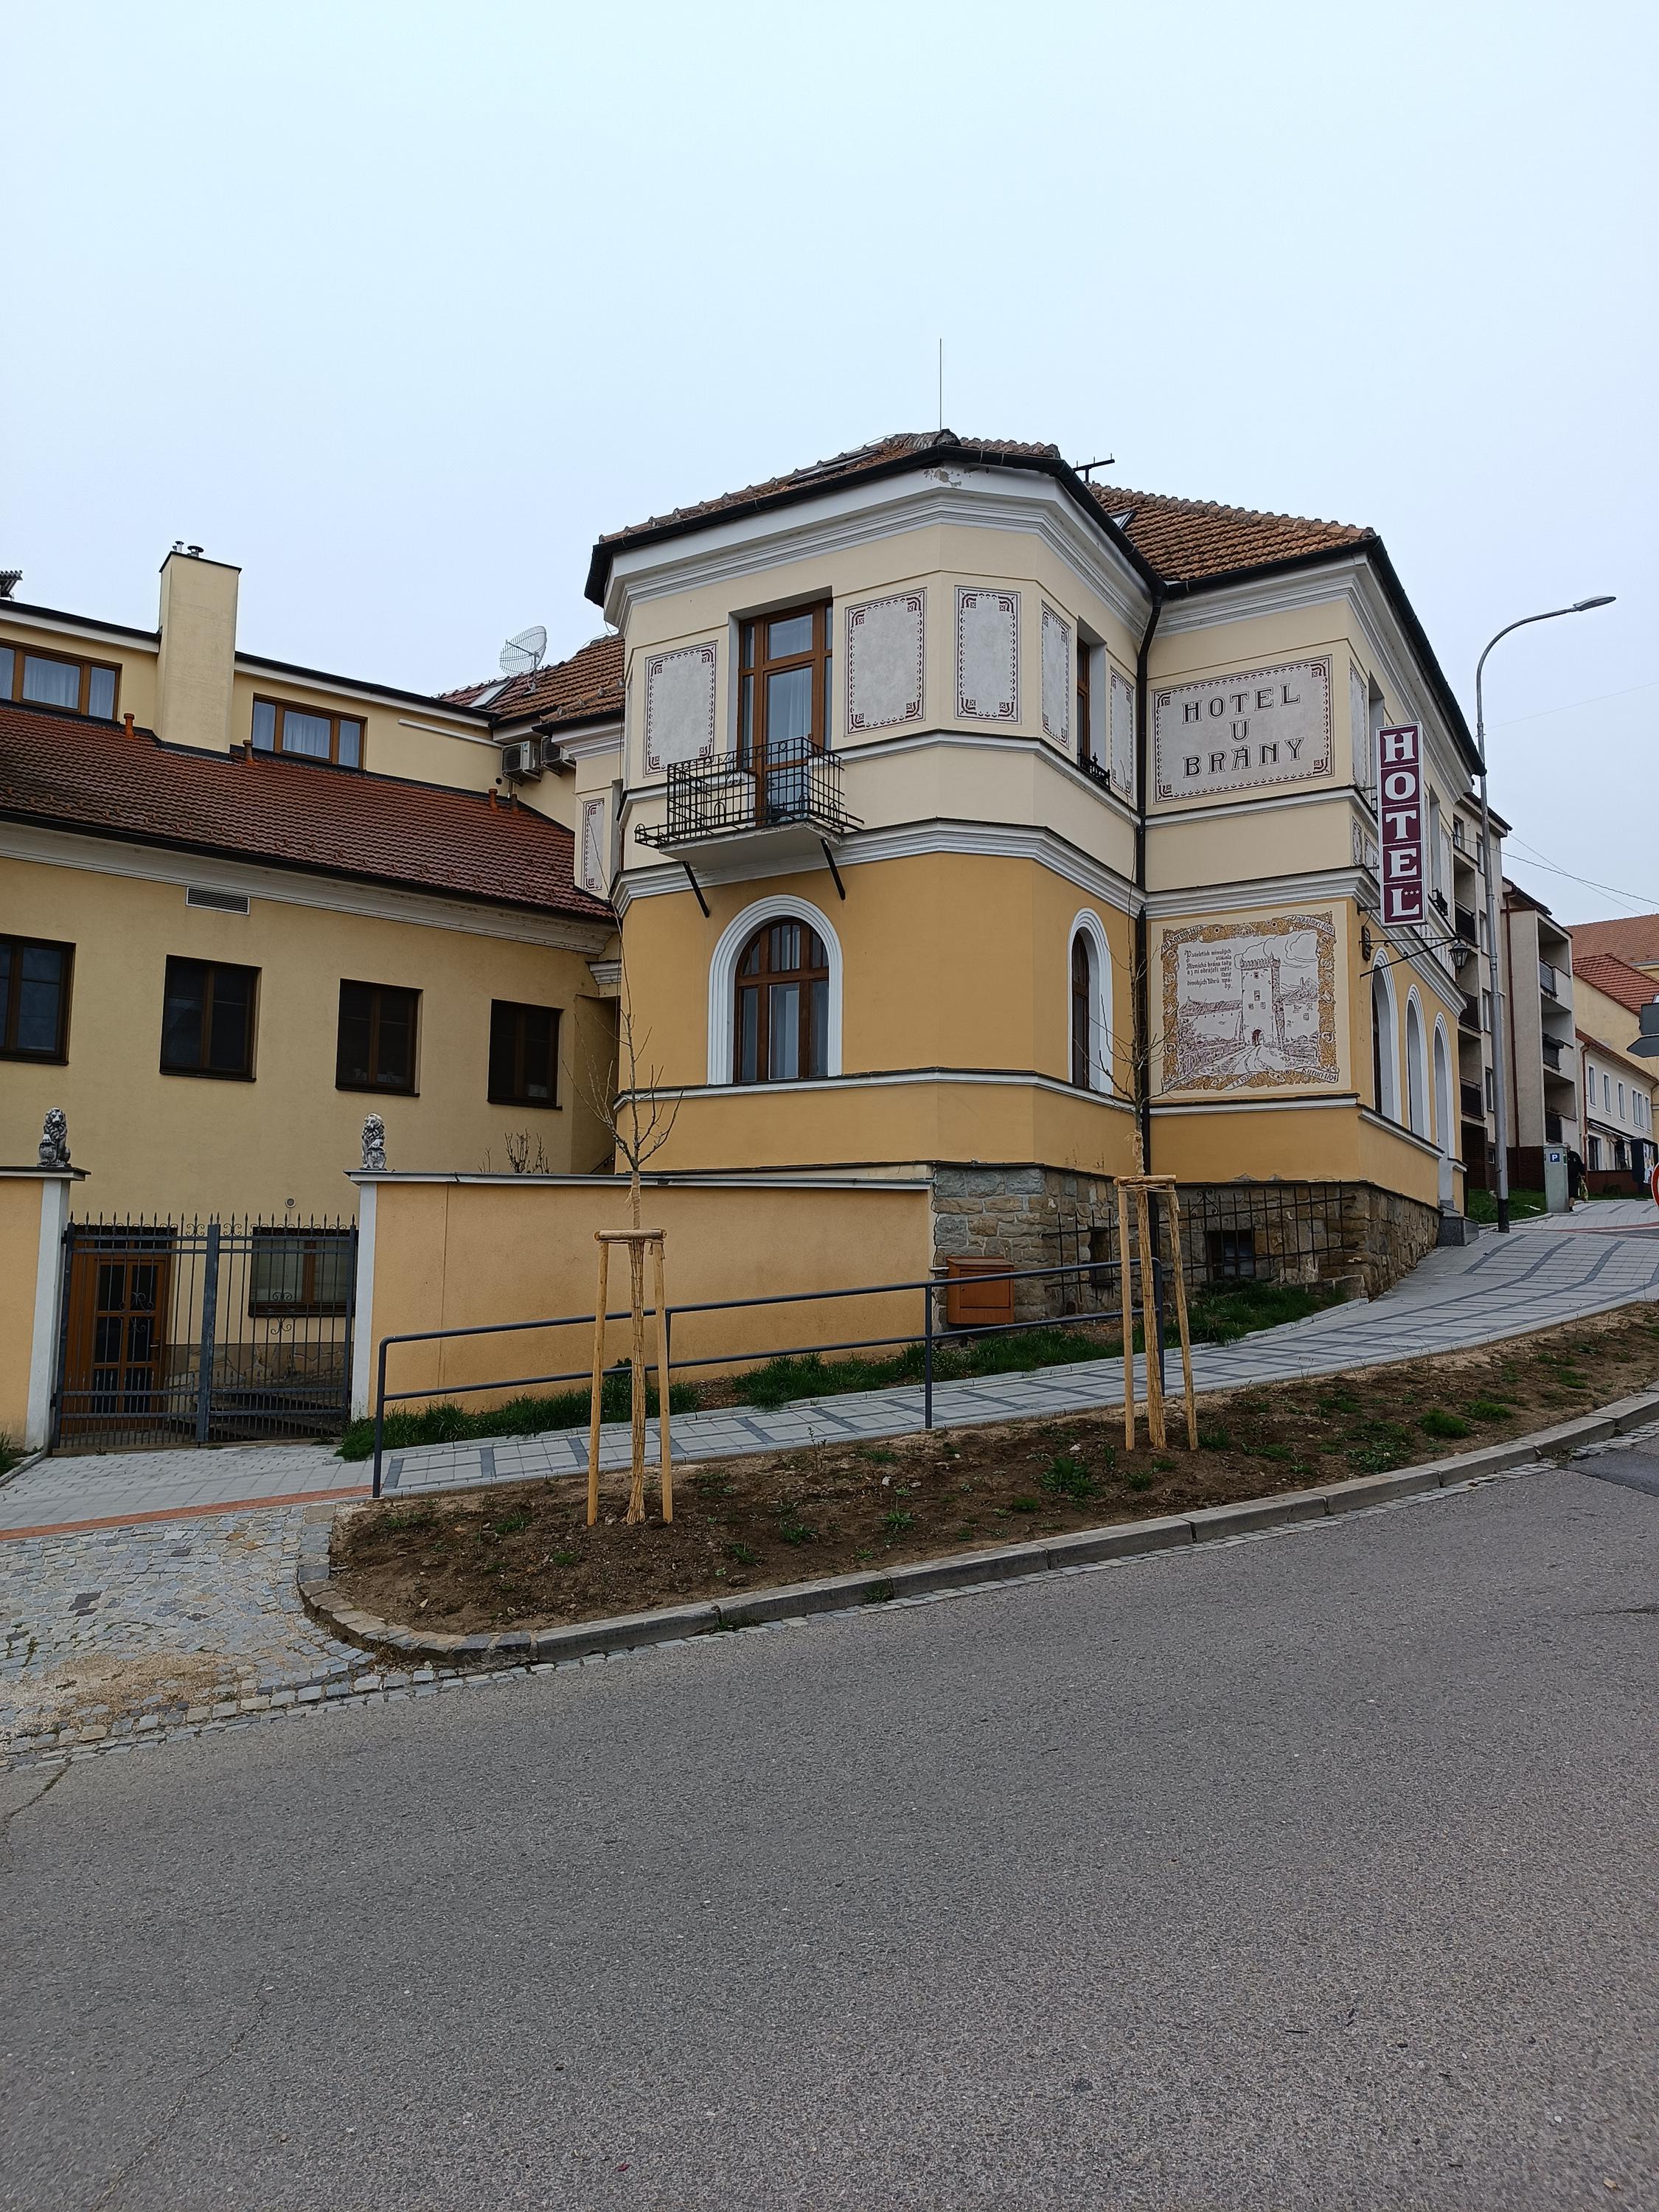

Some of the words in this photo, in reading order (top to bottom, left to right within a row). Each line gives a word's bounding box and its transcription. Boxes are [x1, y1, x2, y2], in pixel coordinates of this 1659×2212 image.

[1182, 683, 1301, 725] HOTEL
[1229, 718, 1251, 742] U
[1182, 737, 1304, 779] BRÁNY
[1382, 730, 1422, 918] HOTEL
